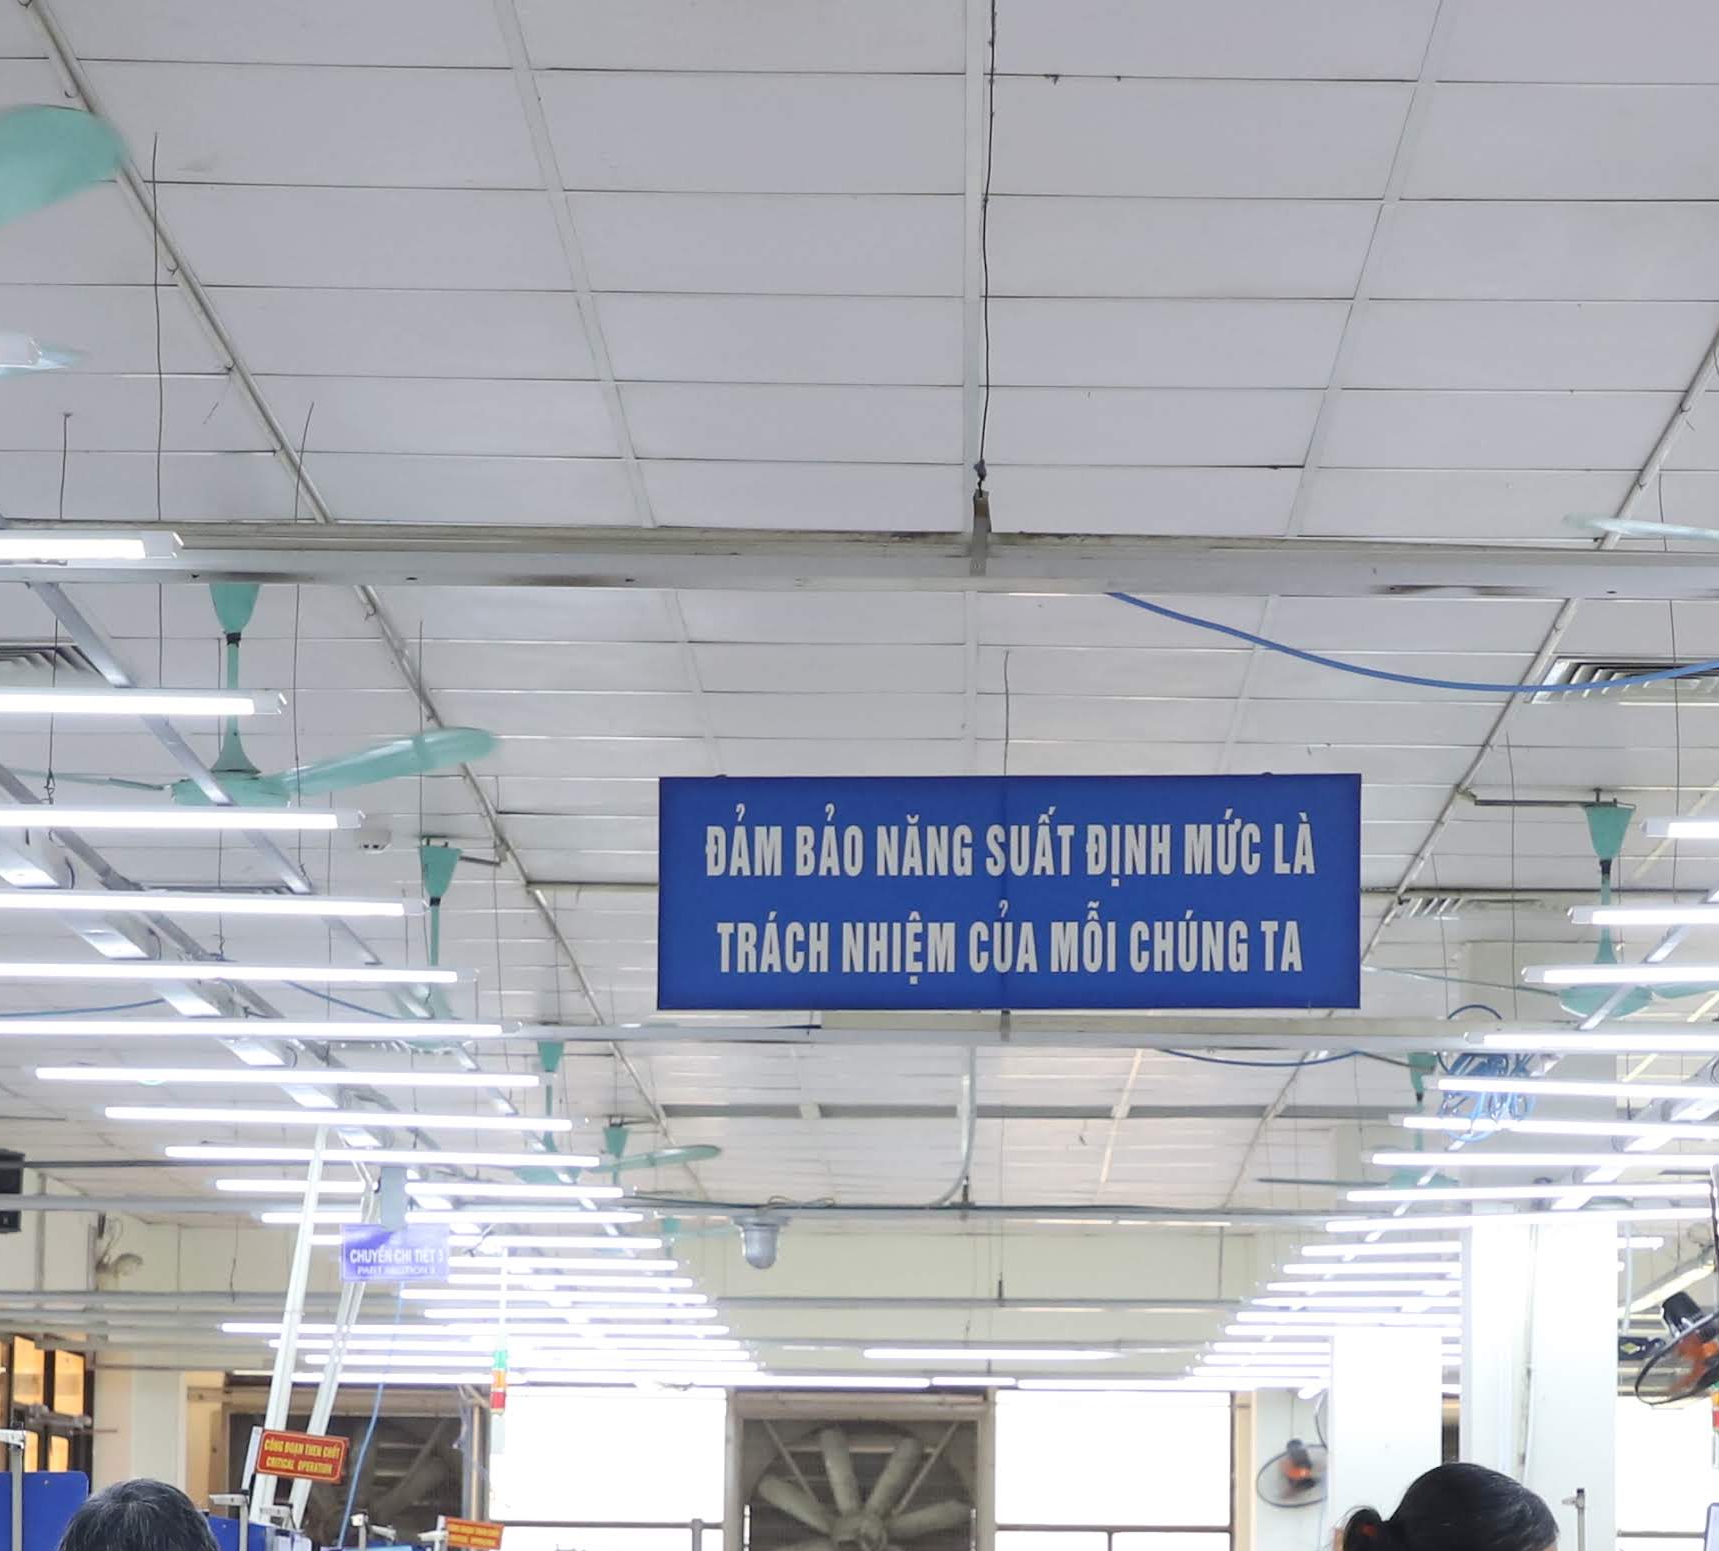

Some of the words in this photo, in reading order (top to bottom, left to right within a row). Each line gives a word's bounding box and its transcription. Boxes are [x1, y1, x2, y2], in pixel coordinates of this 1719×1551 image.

[705, 803, 782, 877] ĐẢM
[795, 802, 864, 877] BẢO
[876, 814, 973, 877] NĂNG
[985, 806, 1074, 877] SUẤT
[1086, 824, 1171, 887] ĐỊNH
[1184, 808, 1263, 876] MỨC
[1274, 811, 1316, 875] LÀ
[717, 911, 829, 973] TRÁCH
[841, 911, 956, 985] NHIỆM
[969, 900, 1038, 973] CỦA
[1050, 901, 1117, 973] MỖI
[1128, 909, 1248, 972] CHÚNG
[1261, 920, 1303, 972] TA
